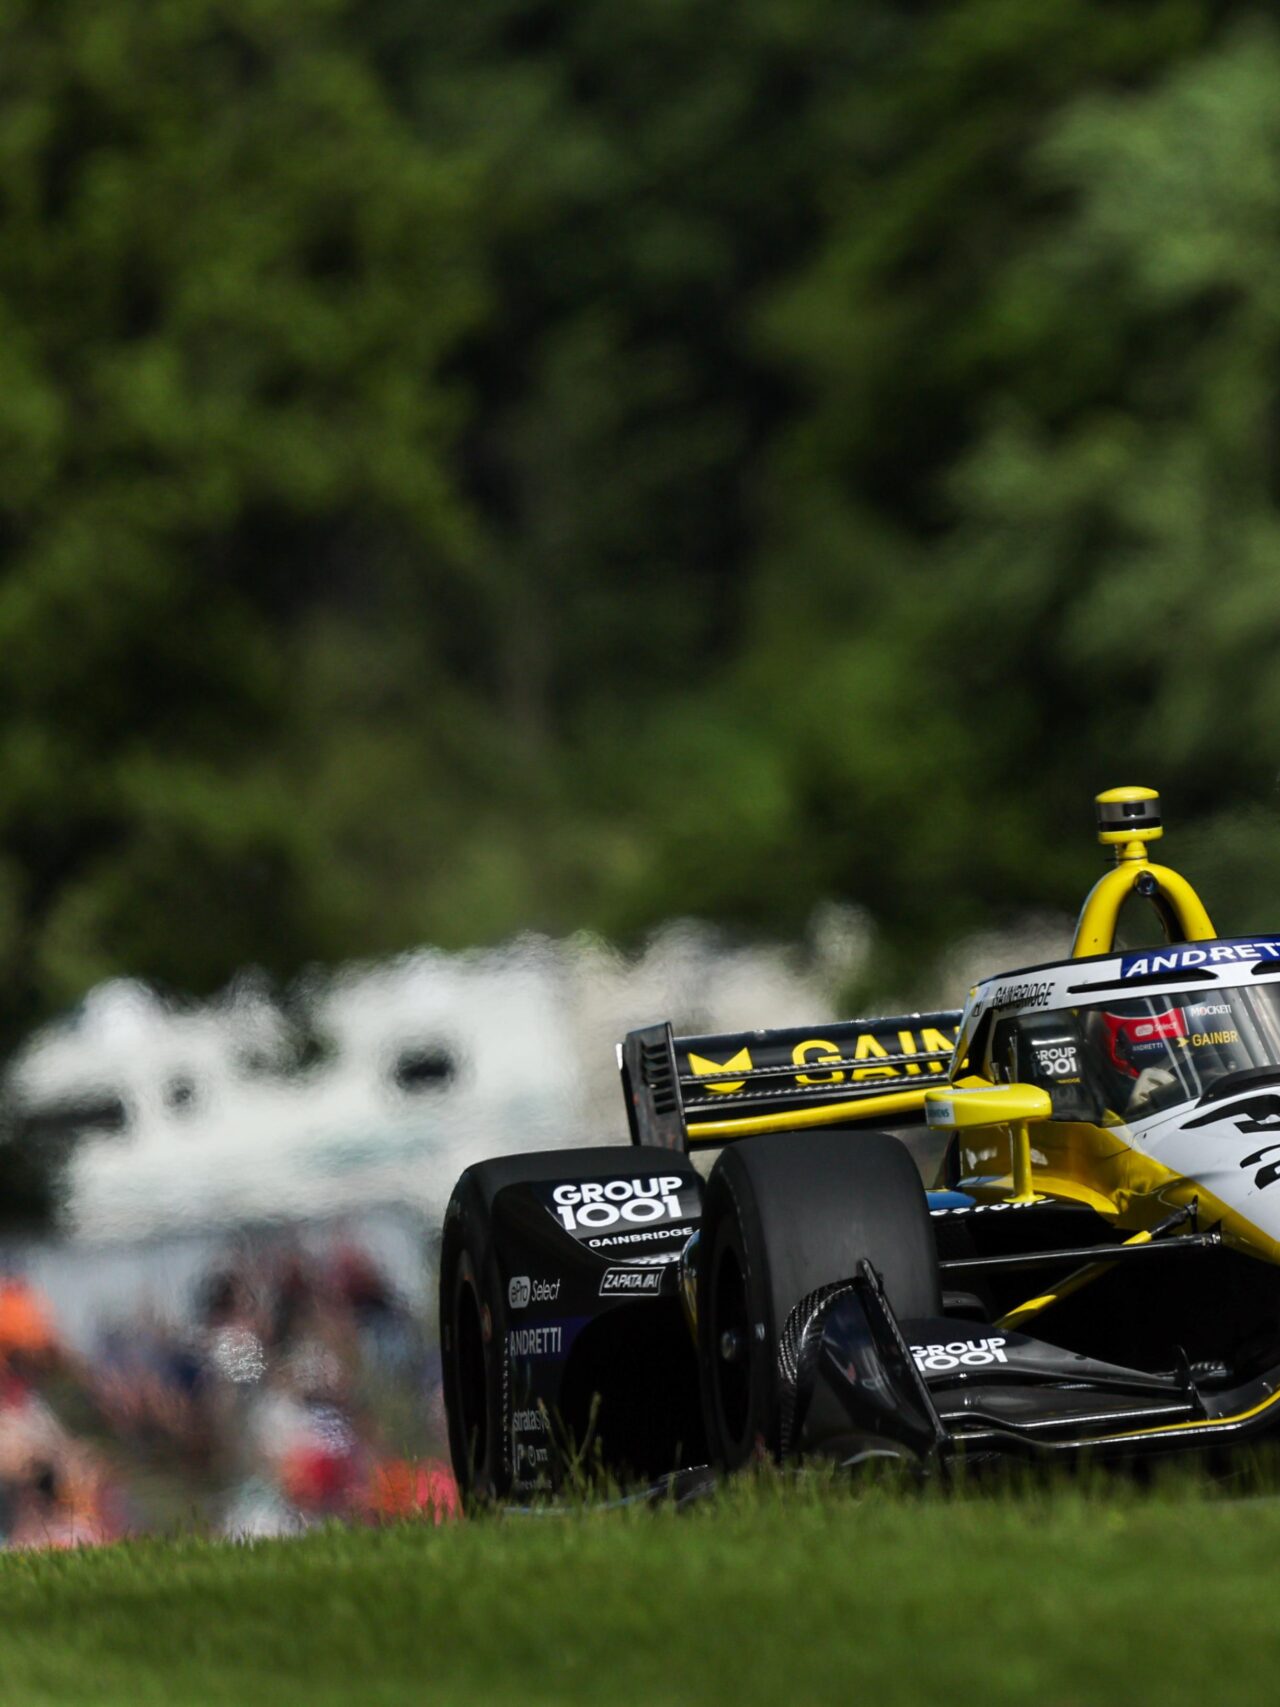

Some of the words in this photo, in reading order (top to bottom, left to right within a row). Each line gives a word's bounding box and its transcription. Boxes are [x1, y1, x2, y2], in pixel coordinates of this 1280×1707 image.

[552, 1175, 683, 1206] GROUP
[557, 1194, 683, 1231] 1001
[588, 1227, 694, 1248] GAINBRIDGE
[531, 1277, 561, 1302] Select
[510, 1326, 562, 1356] ANDRETTI
[910, 1337, 1007, 1359] GROUP
[914, 1349, 1009, 1371] 1001
